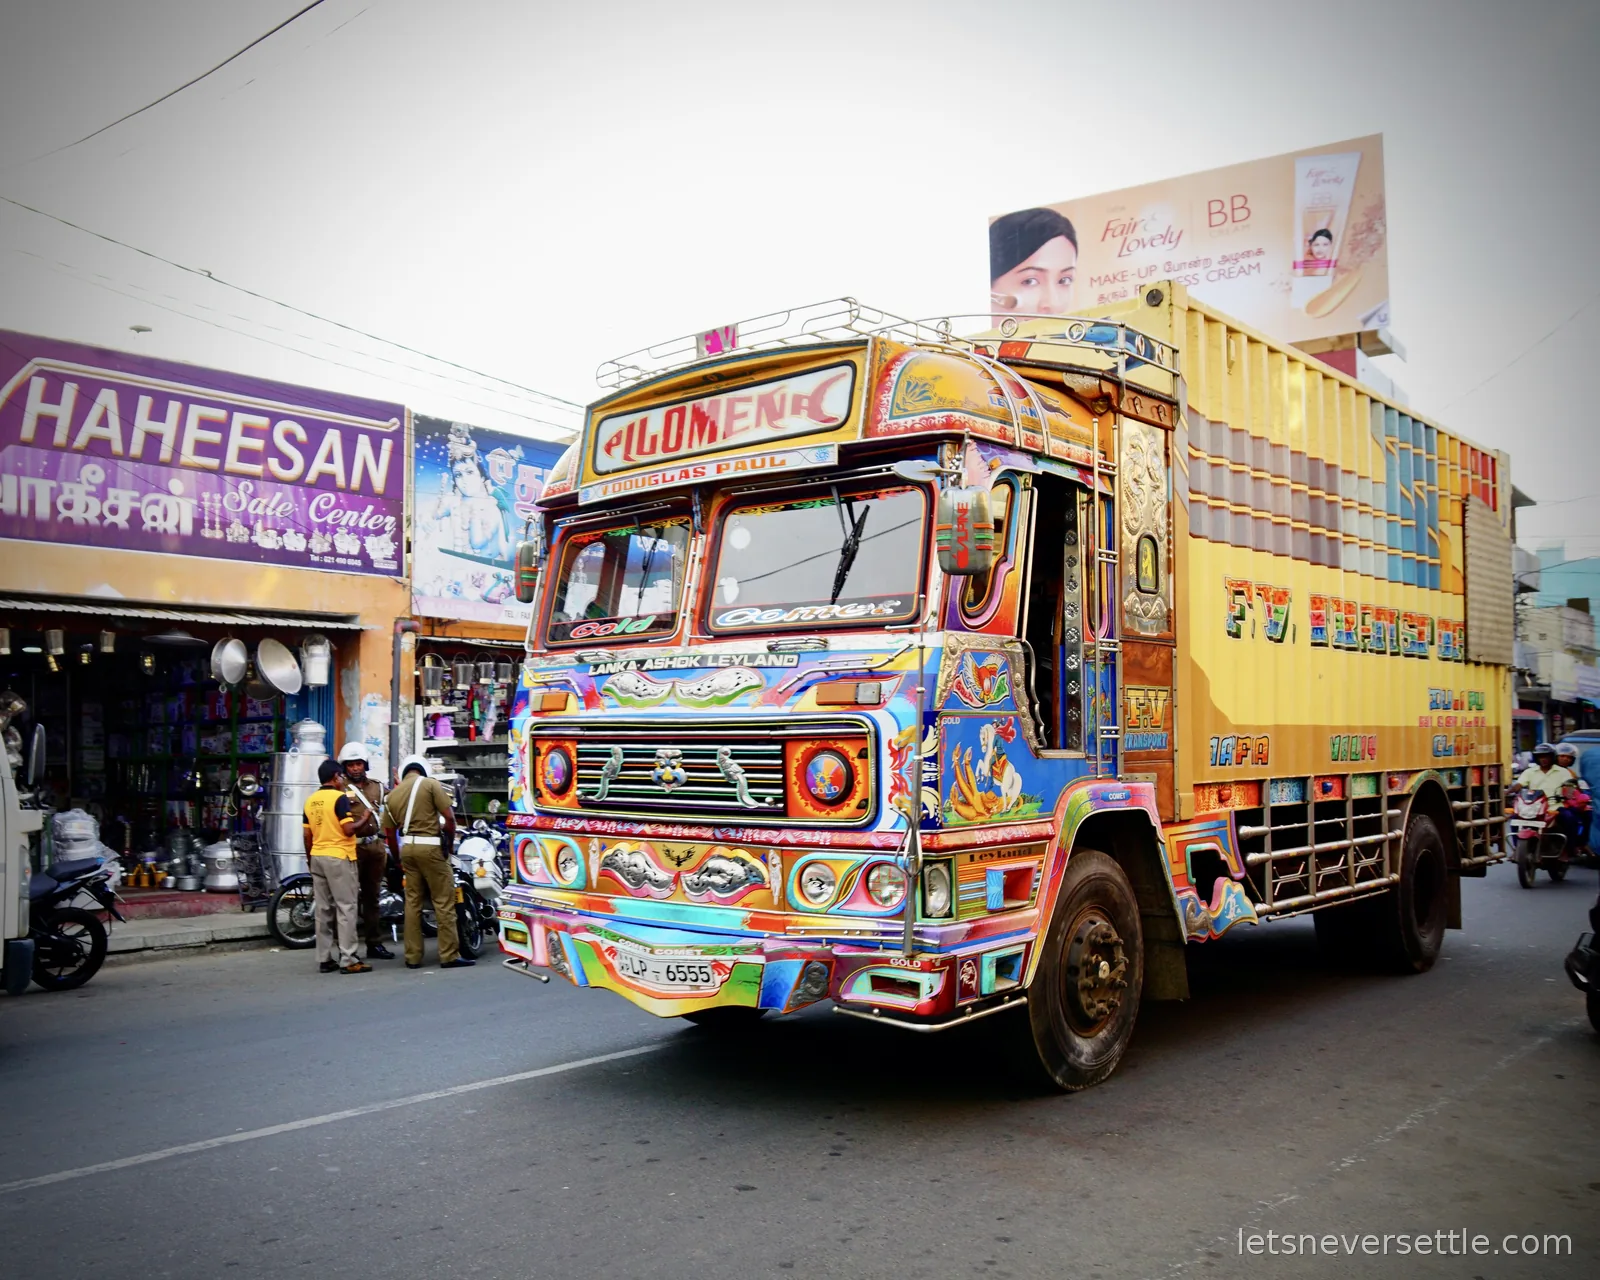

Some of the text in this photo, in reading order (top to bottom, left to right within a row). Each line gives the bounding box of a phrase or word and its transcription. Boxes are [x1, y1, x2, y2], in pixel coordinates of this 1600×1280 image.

[1207, 194, 1250, 228] BB
[1101, 217, 1146, 242] Fair
[1117, 224, 1183, 258] Lovely
[1089, 265, 1158, 289] MAKE-UP
[1206, 262, 1262, 283] CREAM
[20, 376, 393, 494] HAHEESAN
[716, 455, 786, 475] PAUL
[222, 480, 397, 535] Sale Center
[642, 655, 701, 670] ASHOK
[707, 654, 798, 667] LEYLAND
[943, 717, 961, 725] GOLD
[1125, 732, 1168, 751] TRANSPORT
[811, 786, 839, 795] GOLD
[654, 948, 703, 956] COMET
[630, 957, 648, 977] LP
[666, 964, 711, 983] 6555
[890, 958, 921, 968] GOLD
